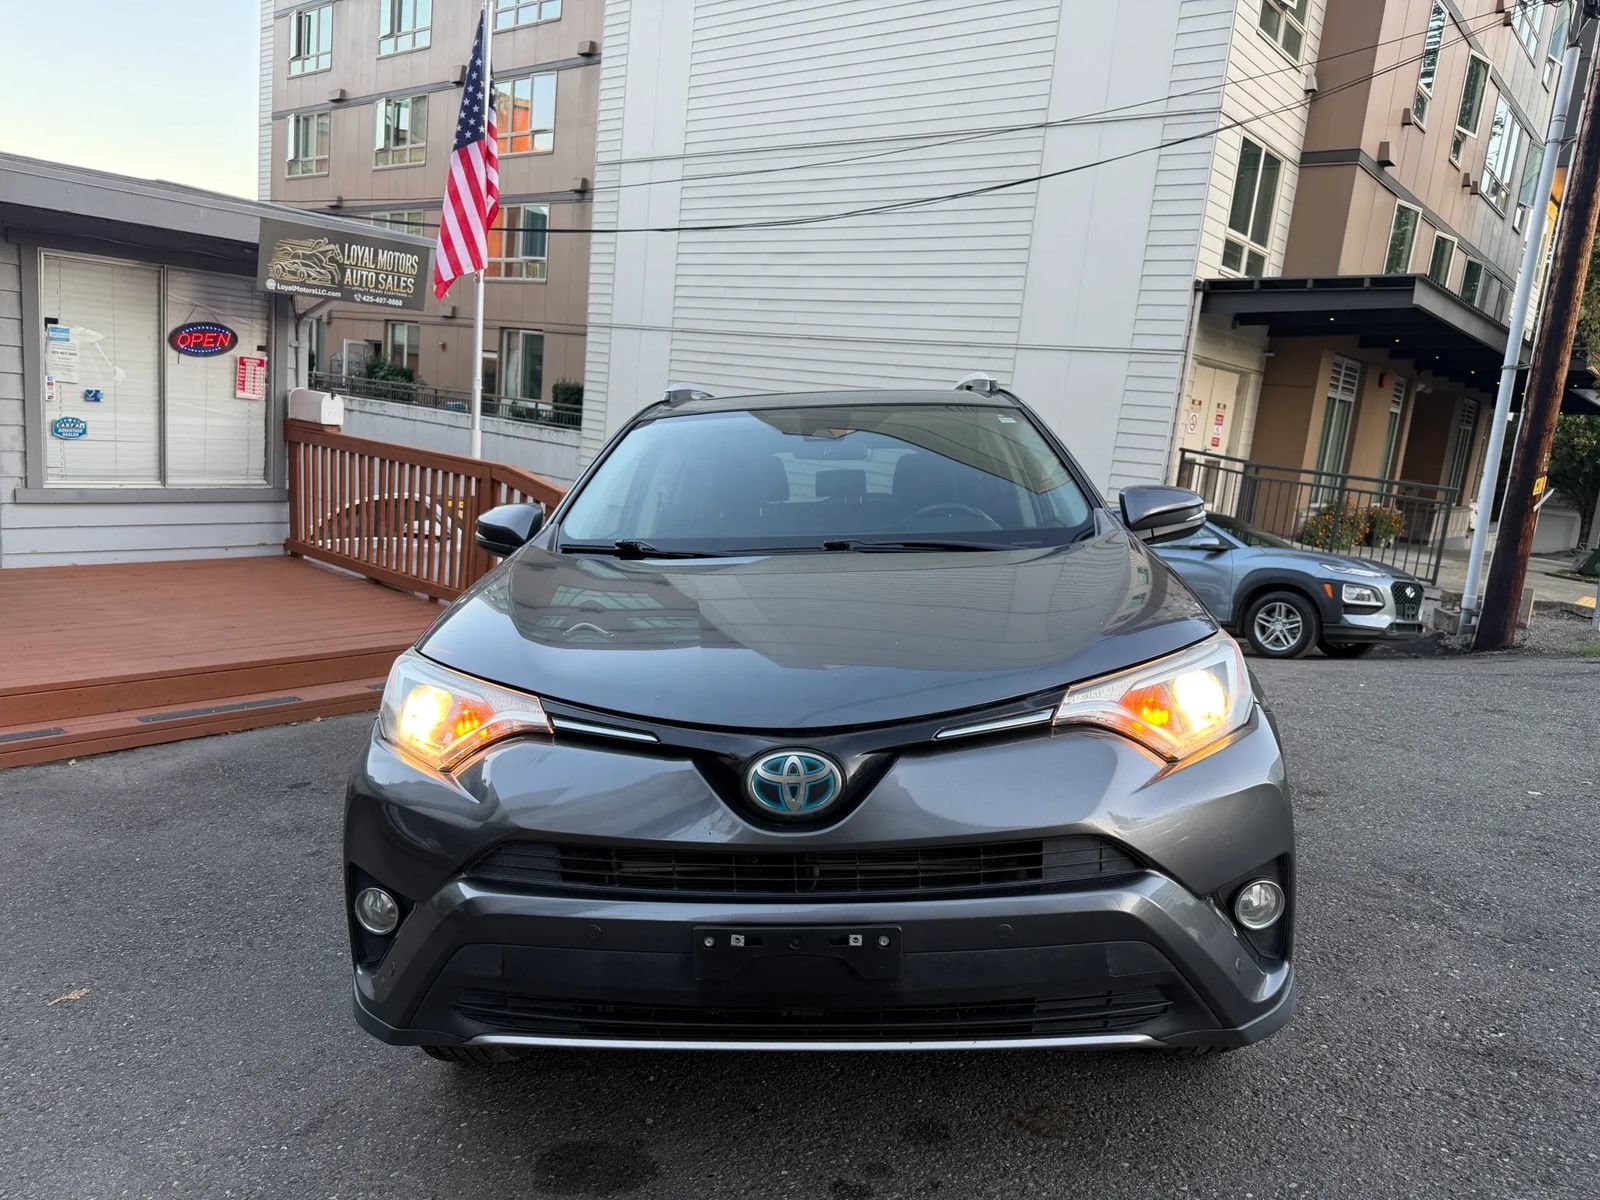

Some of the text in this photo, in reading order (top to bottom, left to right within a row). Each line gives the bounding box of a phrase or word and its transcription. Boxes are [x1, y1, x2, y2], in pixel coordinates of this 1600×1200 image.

[344, 243, 419, 275] LOYAL MOTORS
[277, 283, 342, 298] LoyalMotorsLLC.com
[344, 268, 415, 294] AUTO SALES
[177, 332, 232, 348] OPEN
